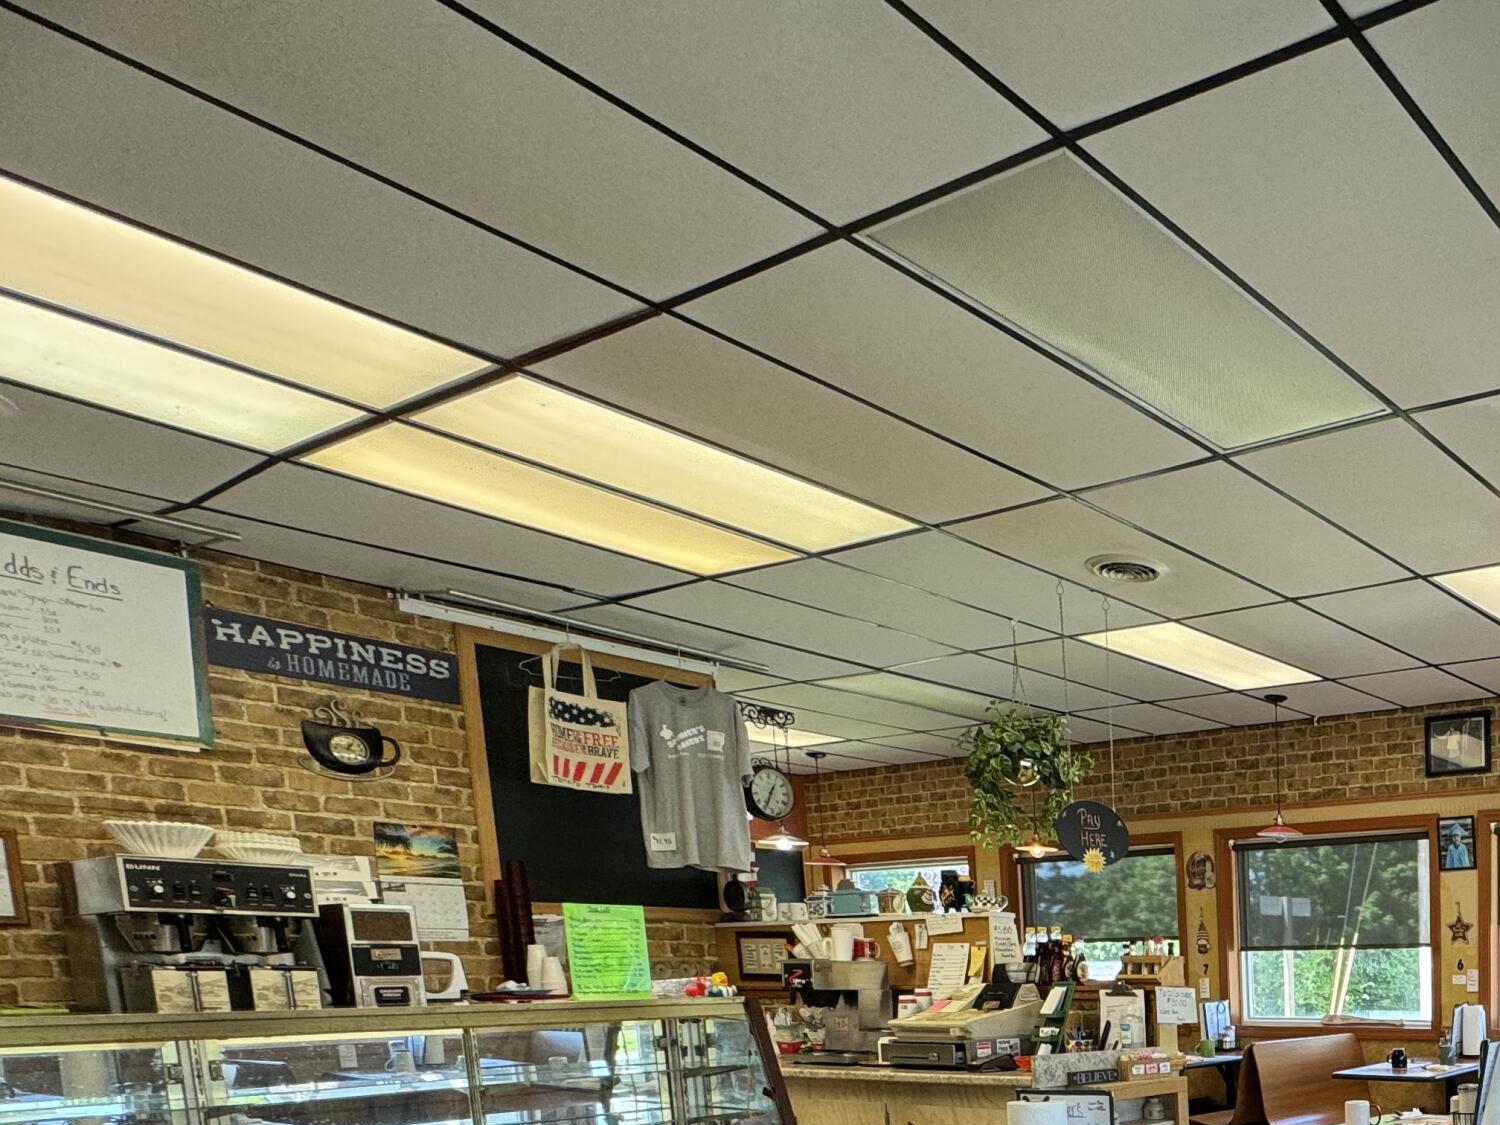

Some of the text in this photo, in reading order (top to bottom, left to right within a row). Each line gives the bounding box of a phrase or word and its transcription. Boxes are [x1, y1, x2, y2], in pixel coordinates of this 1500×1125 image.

[2, 552, 45, 581] dds
[66, 565, 122, 596] Ends
[211, 618, 450, 680] HAPPINESS
[286, 653, 411, 692] HOMEMADE
[583, 731, 620, 749] FREE
[588, 745, 620, 759] BRAVE
[1081, 831, 1108, 848] HERE
[1203, 963, 1209, 975] 7
[1456, 958, 1465, 971] 6
[1077, 1070, 1115, 1084] BELIEVE
